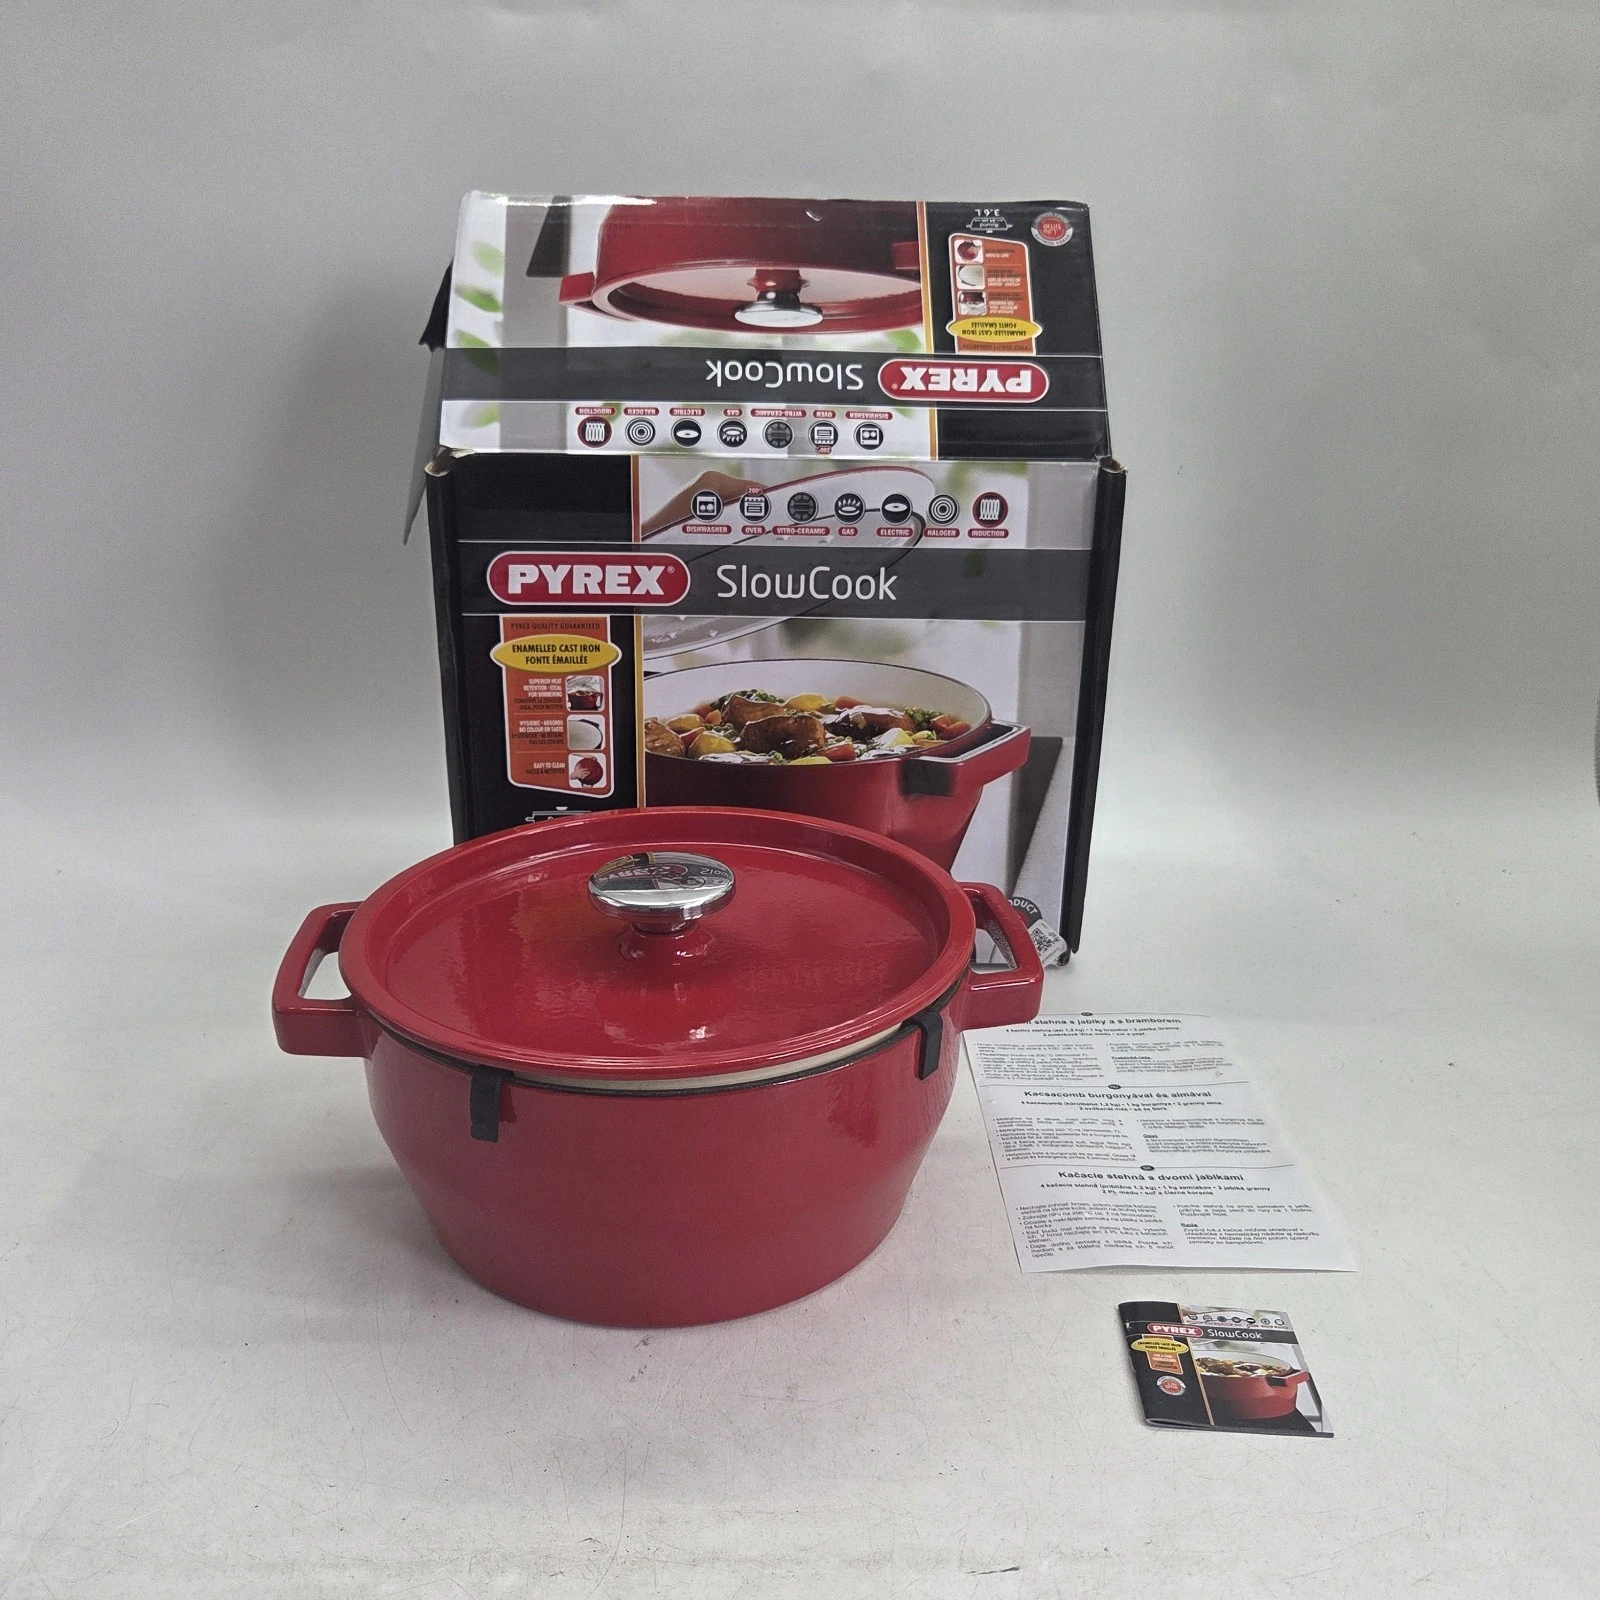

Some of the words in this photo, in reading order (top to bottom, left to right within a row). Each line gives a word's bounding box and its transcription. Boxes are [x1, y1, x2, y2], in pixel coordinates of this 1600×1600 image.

[706, 360, 864, 390] SlowCook
[900, 366, 1032, 394] PYREX
[508, 564, 667, 596] PYREX
[717, 564, 898, 600] SlowCook
[512, 644, 557, 653] ENAMELLED
[559, 644, 578, 652] CAST
[580, 644, 600, 652] IRON
[526, 656, 550, 664] FONTE
[552, 655, 588, 664] ÉMAILLÉE
[1152, 1324, 1197, 1335] PYREX
[1207, 1329, 1263, 1339] SlowCook
